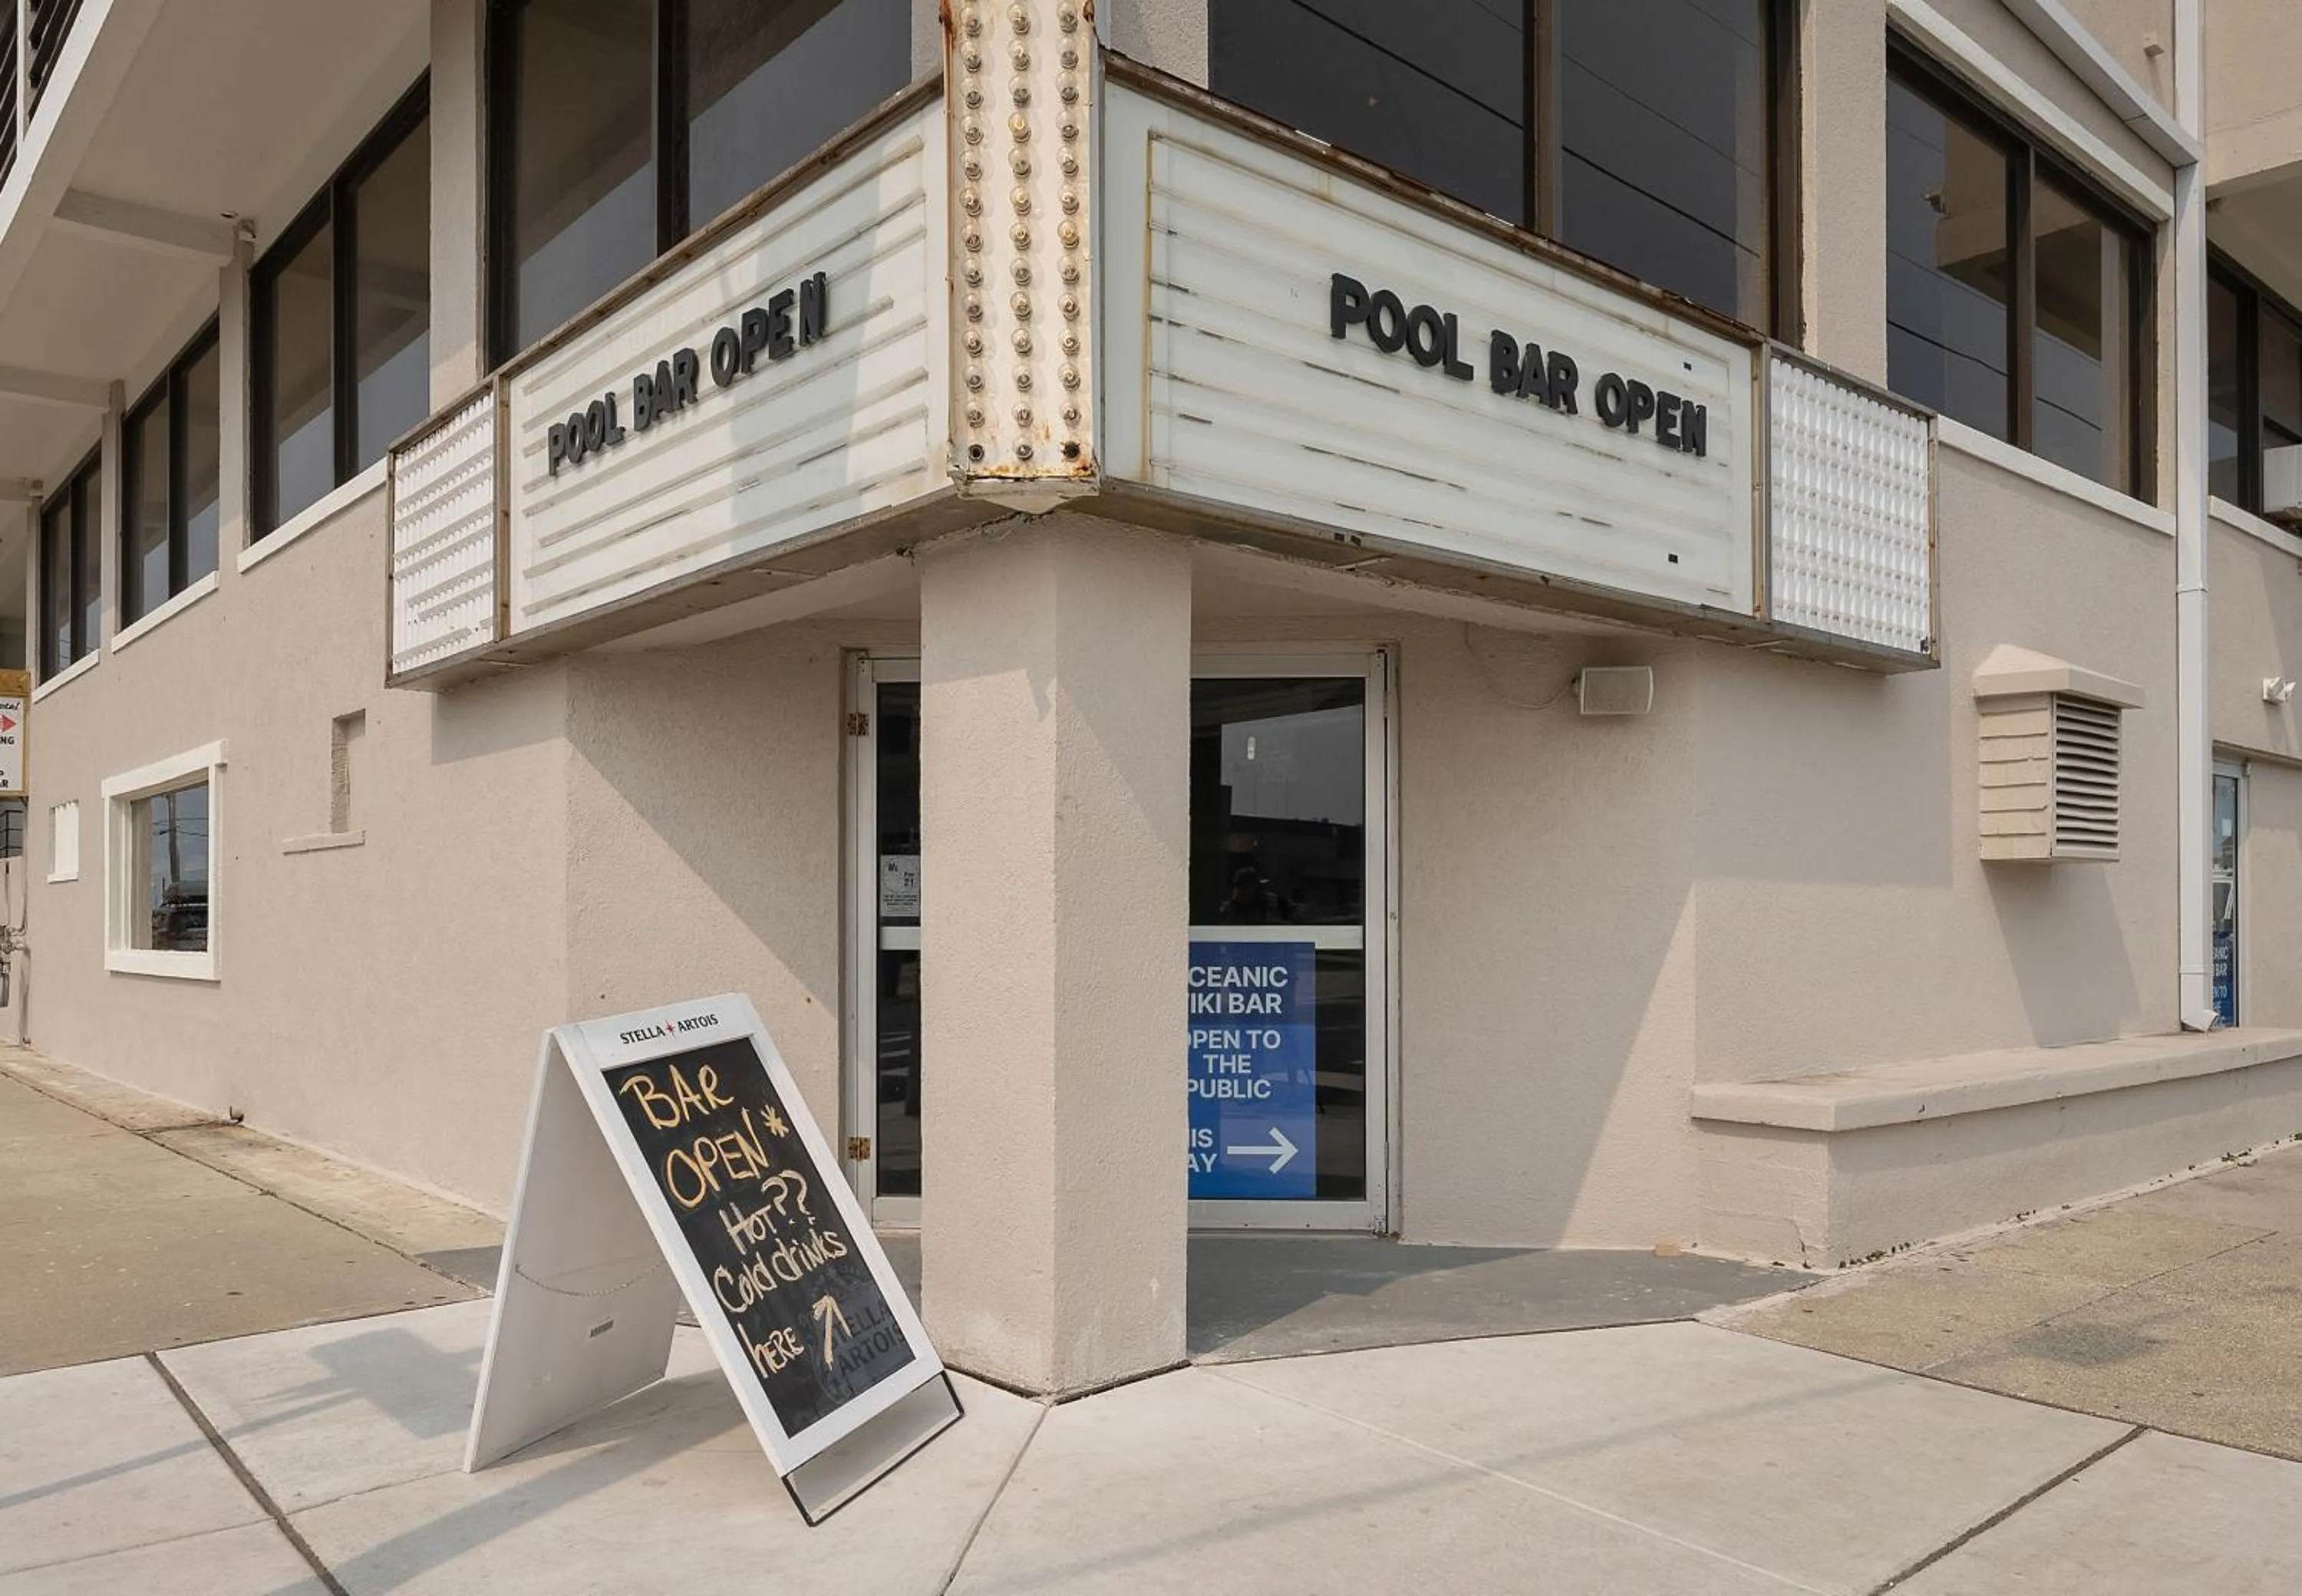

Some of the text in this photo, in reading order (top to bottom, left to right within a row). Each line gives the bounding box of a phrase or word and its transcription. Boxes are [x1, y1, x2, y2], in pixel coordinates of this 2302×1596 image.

[547, 271, 826, 476] POOL BAR OPEN
[1331, 272, 1707, 457] POOL BAR OPEN
[1188, 966, 1288, 988] CEANIC
[1189, 993, 1281, 1014] IKI BAR
[619, 1014, 718, 1044] STELLA ARTOIS
[1187, 1029, 1281, 1049] PEN TO
[1202, 1054, 1251, 1073] THE
[620, 1064, 735, 1130] BAR
[1187, 1079, 1271, 1098] PUBLIC
[1191, 1129, 1212, 1148] IS
[1186, 1153, 1218, 1172] AY
[714, 1251, 777, 1314] Cold
